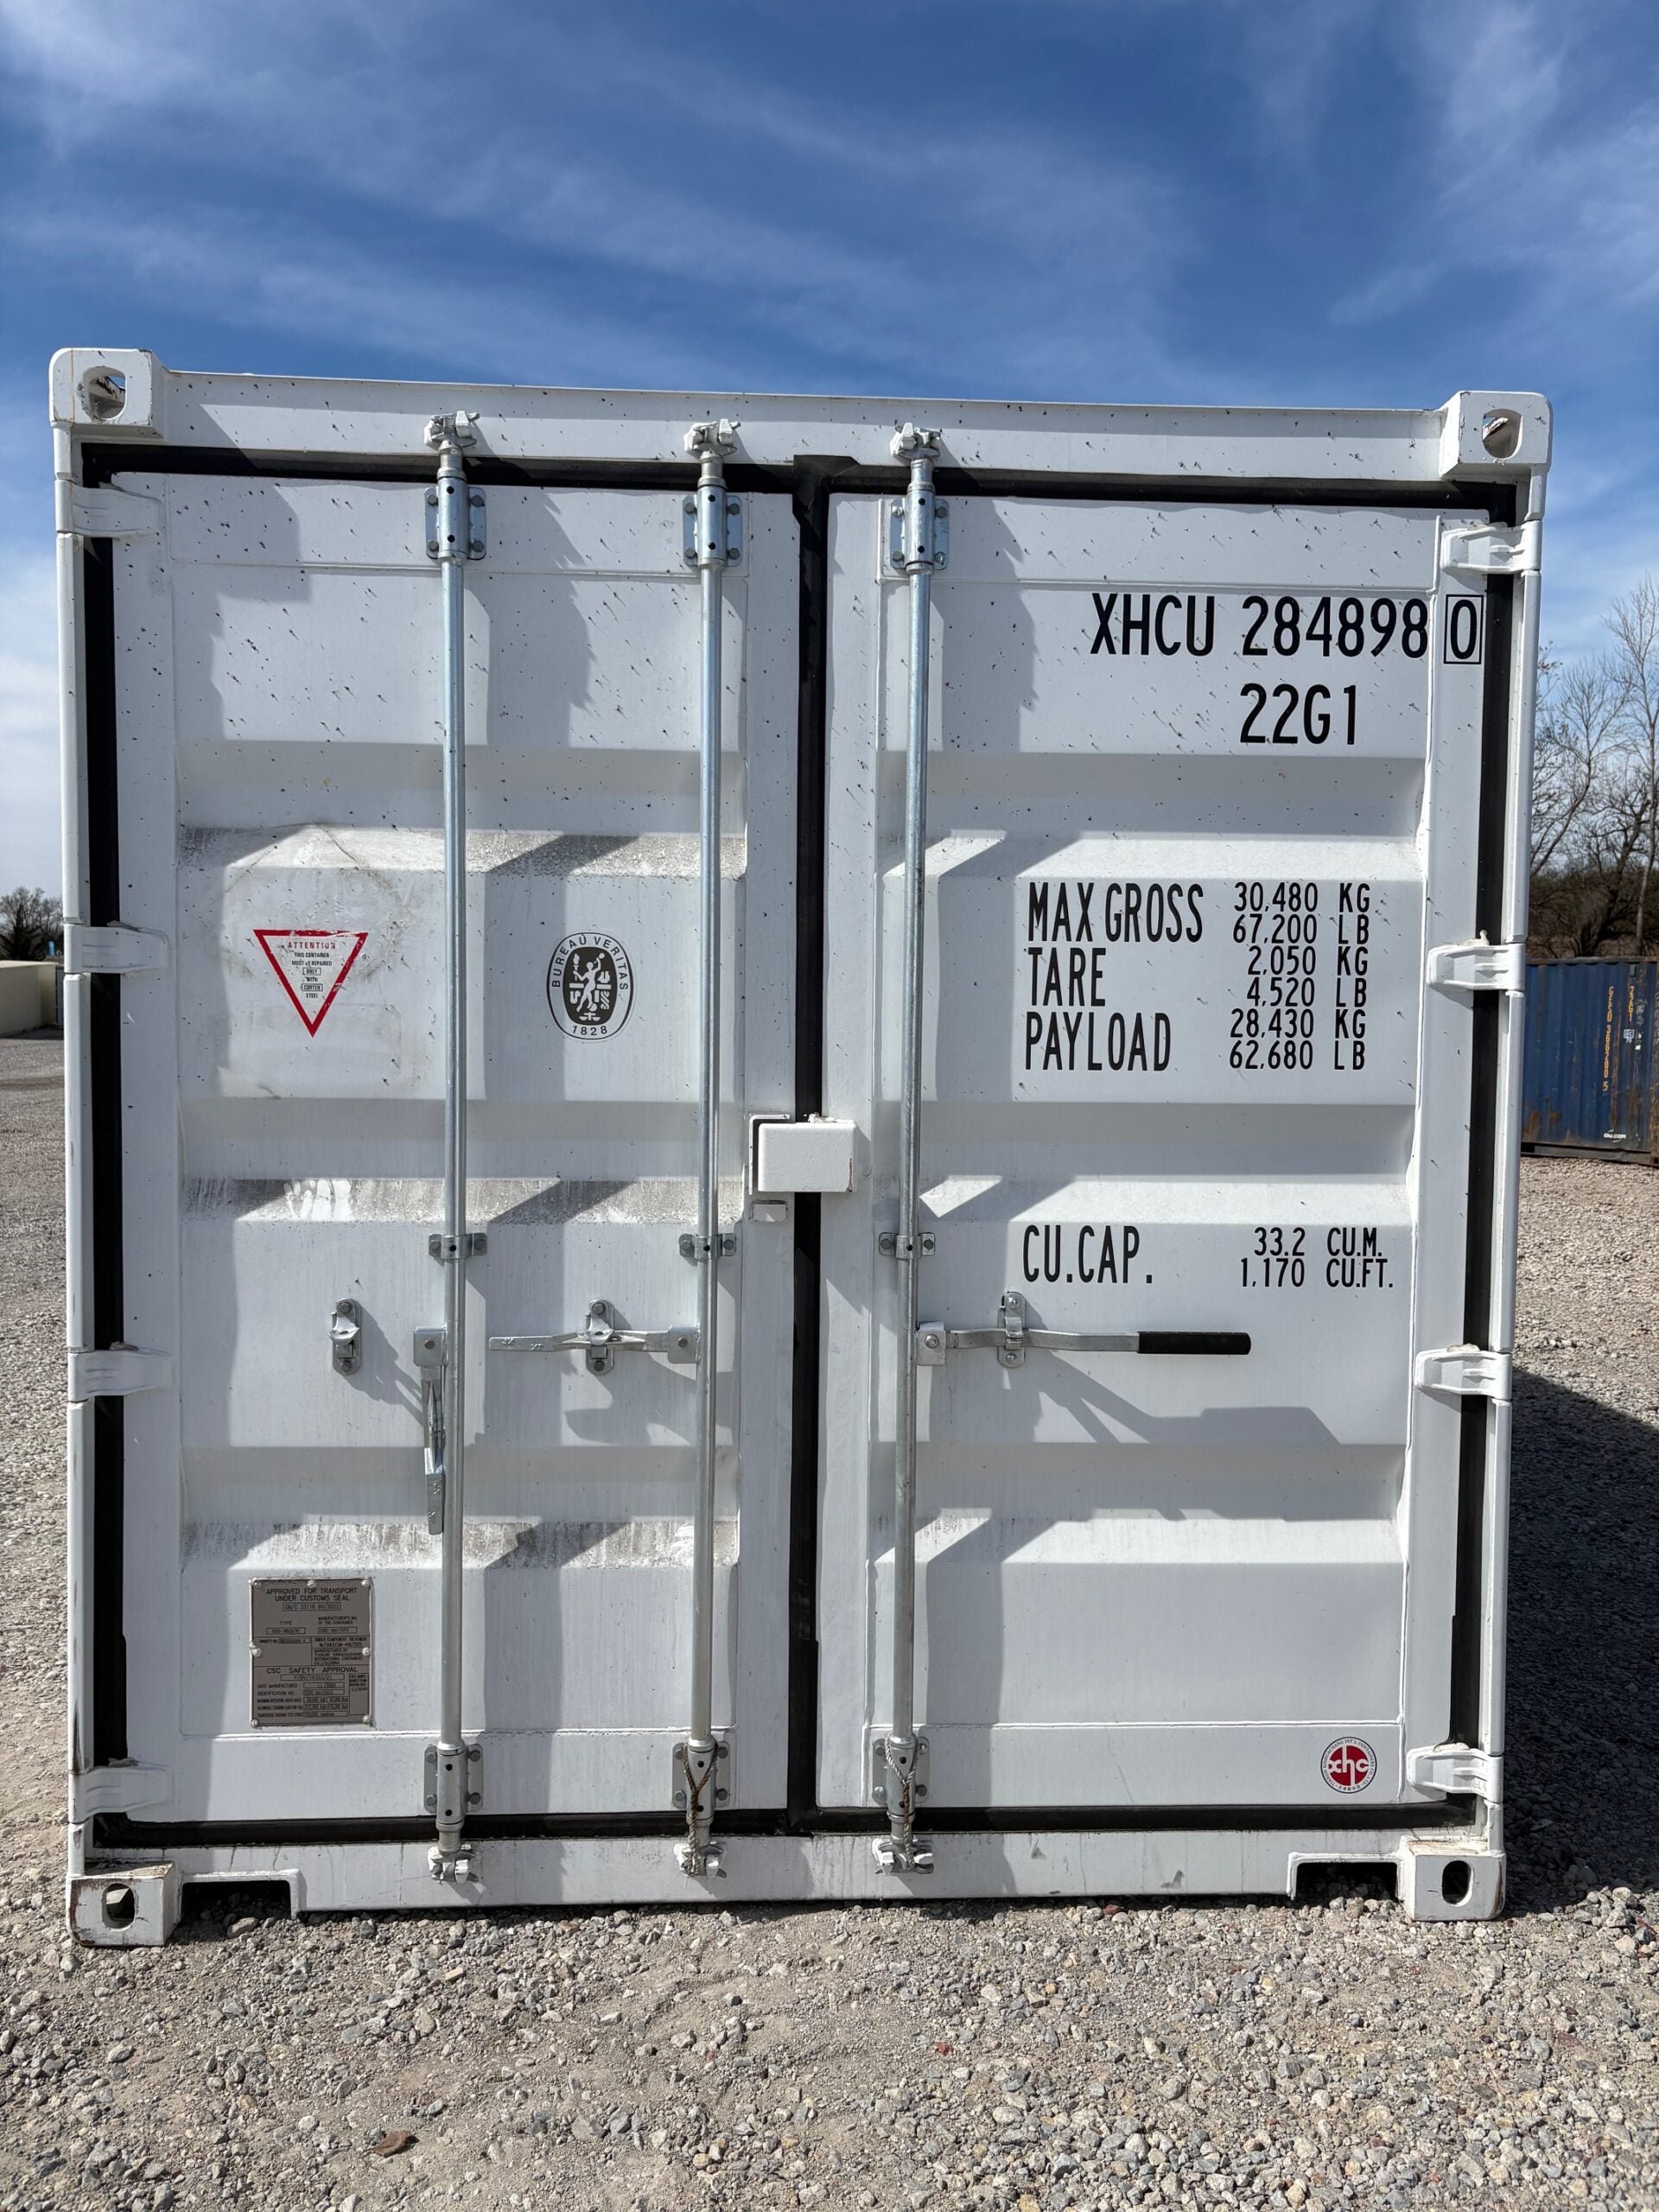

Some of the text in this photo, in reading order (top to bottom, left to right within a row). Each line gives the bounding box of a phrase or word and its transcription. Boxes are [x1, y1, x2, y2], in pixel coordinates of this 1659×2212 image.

[1090, 592, 1478, 660] XHCU 284898 0
[1240, 683, 1357, 746] 22G1
[1027, 881, 1204, 944] MAX GROSS
[1234, 881, 1370, 913] 30,480 KG
[1232, 913, 1370, 945] 67,200 LB
[551, 936, 588, 988] BUREAU
[594, 936, 628, 991] VERITAS
[1247, 944, 1369, 976] 2,050 KG
[1027, 946, 1107, 1007] TARE
[1246, 976, 1367, 1007] 4,520 LB
[572, 1025, 607, 1036] 1828
[1230, 1007, 1366, 1039] 28,430 KG
[1025, 1011, 1171, 1071] PAYLOAD
[1229, 1039, 1365, 1071] 62,680 LB
[1022, 1224, 1153, 1284] CU.CAP.
[1254, 1226, 1382, 1257] 33.2 CU.M.
[1241, 1257, 1394, 1288] 1,170 CU.FT.
